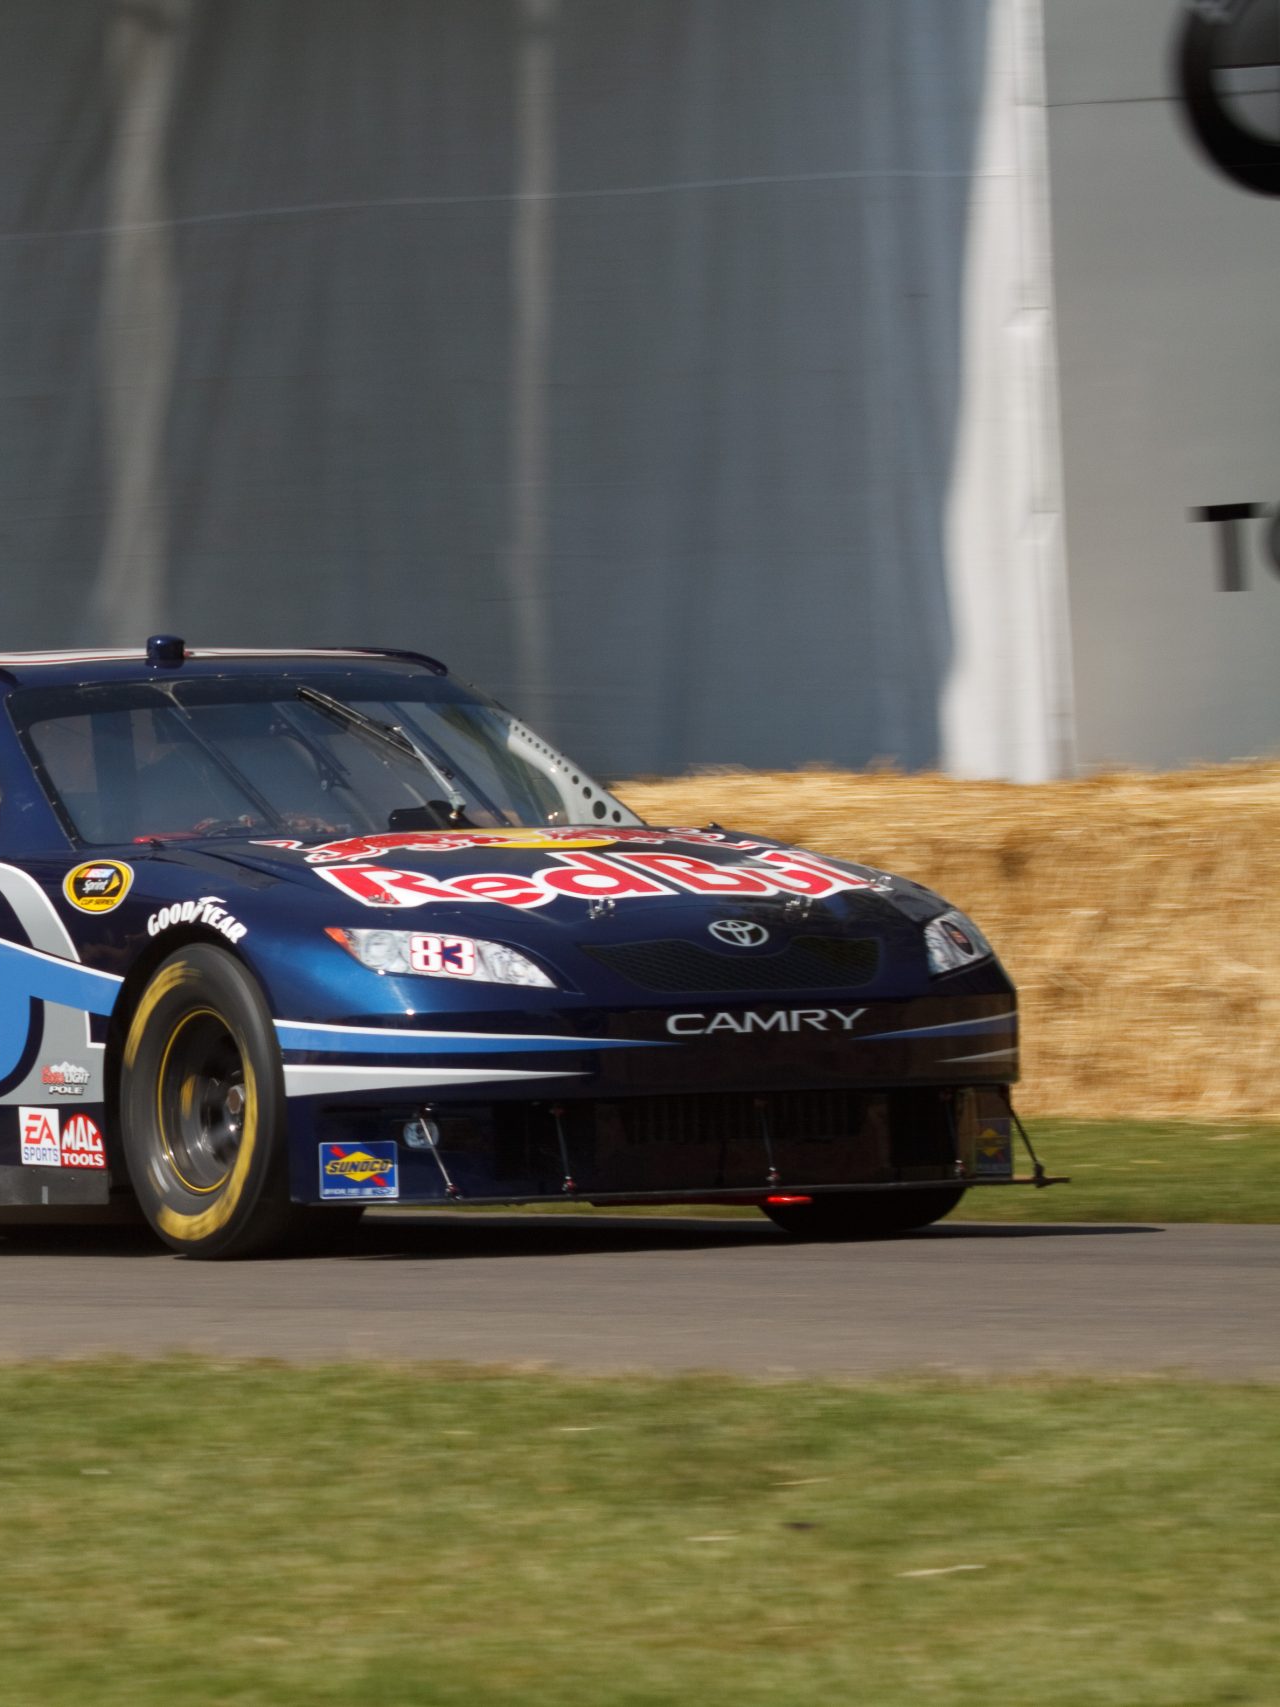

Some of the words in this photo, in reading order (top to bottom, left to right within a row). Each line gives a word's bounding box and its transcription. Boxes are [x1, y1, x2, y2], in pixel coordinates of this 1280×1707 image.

[316, 850, 672, 907] Red
[82, 879, 109, 894] Sprint
[147, 896, 248, 944] GOODYEAR
[409, 935, 476, 976] 83
[666, 1008, 869, 1035] CAMRY
[63, 1071, 90, 1085] LIGHT
[49, 1086, 84, 1095] POLE
[25, 1114, 56, 1146] EA
[23, 1147, 59, 1162] SPORTS
[61, 1153, 105, 1167] TOOLS
[327, 1160, 392, 1174] SUNOCO
